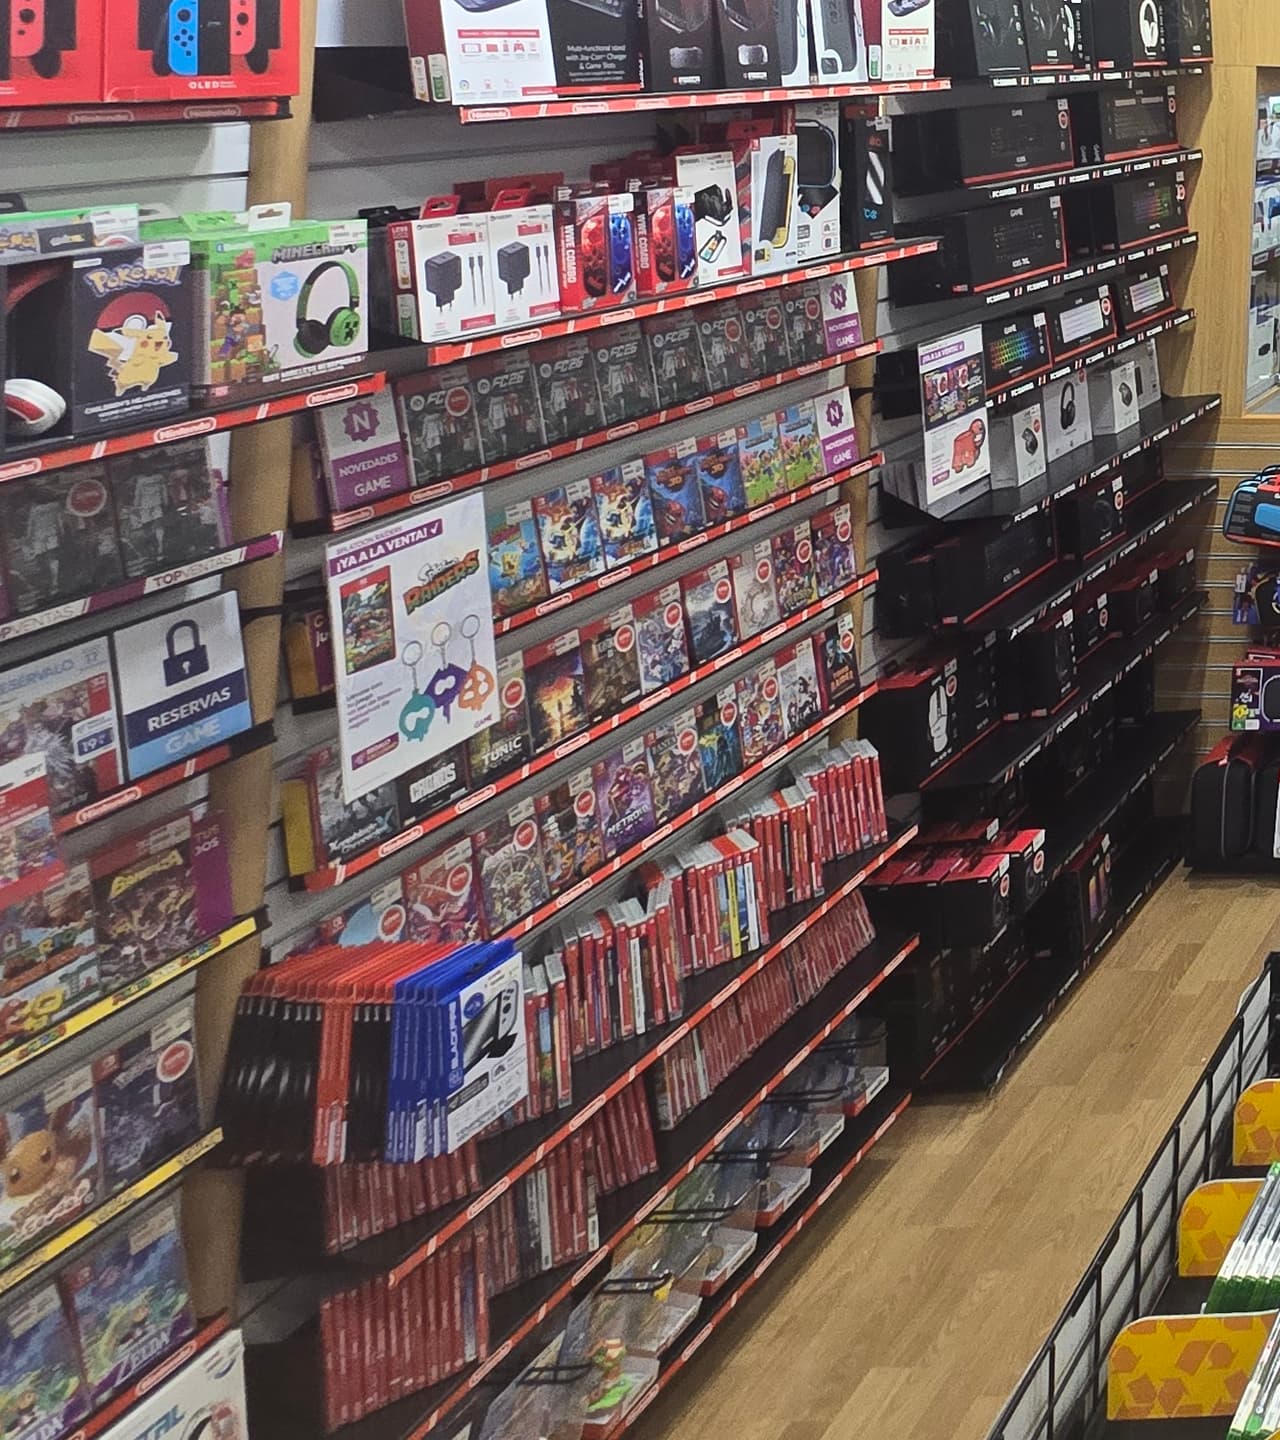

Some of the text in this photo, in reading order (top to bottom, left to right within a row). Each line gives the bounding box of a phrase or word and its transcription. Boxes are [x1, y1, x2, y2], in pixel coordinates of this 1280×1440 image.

[187, 80, 220, 90] OLED
[567, 250, 578, 284] COMBO
[836, 333, 855, 347] GAME
[309, 387, 354, 404] Nintendo
[160, 420, 211, 440] Nintendo
[339, 452, 398, 477] NOVEDADES
[354, 476, 391, 496] GAME
[336, 527, 428, 574] ¡YA A LA VENTA!
[403, 548, 480, 615] RAIDERS
[148, 687, 232, 732] RESERVAS
[165, 719, 222, 754] GAME
[482, 737, 523, 766] TUNIC
[607, 804, 649, 836] METROID
